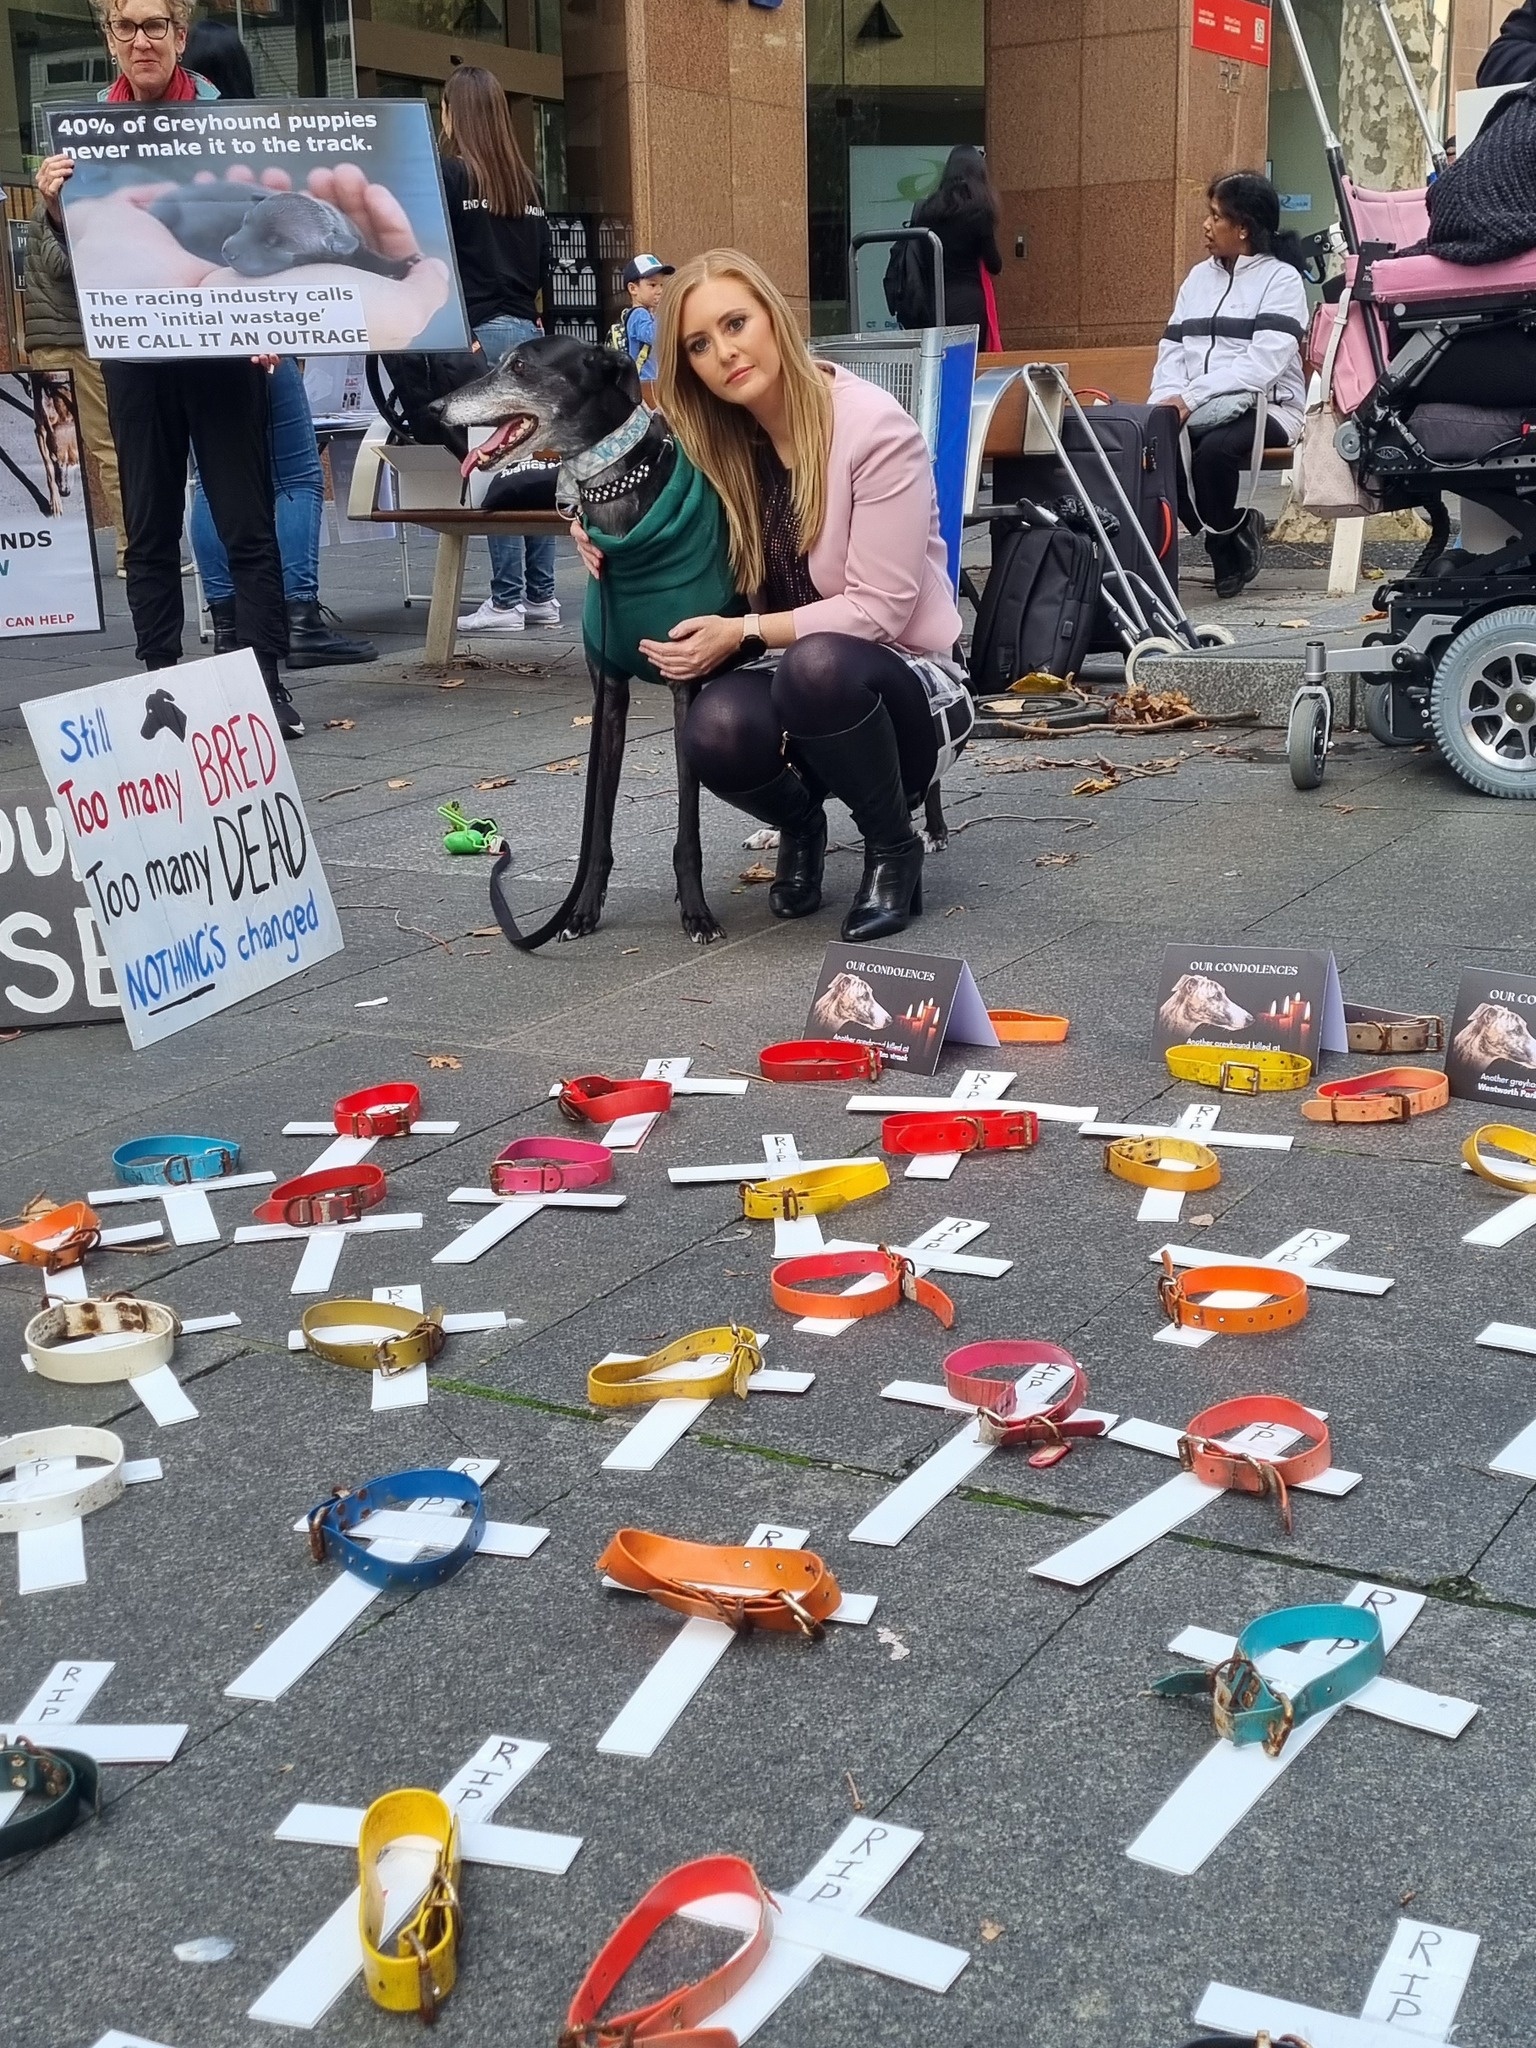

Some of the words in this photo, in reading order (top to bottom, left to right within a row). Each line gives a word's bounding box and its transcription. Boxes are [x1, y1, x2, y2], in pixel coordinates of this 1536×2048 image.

[58, 118, 115, 136] 40%
[123, 116, 146, 134] of
[154, 113, 281, 135] Greyhound
[288, 112, 378, 133] puppies
[62, 144, 130, 160] never
[138, 139, 202, 157] make
[208, 138, 226, 154] it
[231, 138, 257, 154] to
[261, 136, 301, 154] the
[306, 134, 373, 152] track.
[462, 199, 480, 211] END
[86, 292, 128, 306] The
[135, 290, 203, 308] racing
[209, 289, 299, 305] industry
[306, 287, 354, 301] calls
[90, 313, 148, 327] them
[153, 311, 224, 327] 'initial
[230, 308, 325, 326] wastage'
[93, 335, 130, 349] WE
[137, 334, 193, 349] CALL
[198, 333, 222, 347] IT
[229, 331, 260, 346] AN
[267, 329, 369, 345] OUTRAGE
[5, 616, 35, 628] CAN
[39, 613, 75, 625] HELP
[60, 706, 113, 763] Still
[57, 778, 110, 838] Too
[117, 768, 183, 824] many
[191, 712, 277, 807] BRED
[85, 860, 140, 926] Too
[145, 845, 214, 906] many
[213, 791, 307, 901] DEAD
[124, 922, 227, 1011] NOTHING'S
[236, 888, 320, 964] changed
[846, 960, 865, 972] OUR
[866, 963, 936, 982] CONDOLENCES
[1190, 961, 1213, 972] OUR
[1214, 962, 1299, 976] CONDOLENCES
[1489, 989, 1516, 1003] OUR
[1186, 1037, 1215, 1047] Another
[1252, 1041, 1272, 1051] killed
[967, 1073, 991, 1099] RIP
[1477, 1083, 1519, 1097] Wentworth
[1480, 1072, 1510, 1084] Another
[1190, 1106, 1214, 1130] RIP
[774, 1136, 786, 1162] RIP
[38, 1666, 82, 1721] RIP
[457, 1741, 519, 1804] RIP
[807, 1827, 888, 1903] RIP
[1386, 1930, 1442, 2023] RIP
